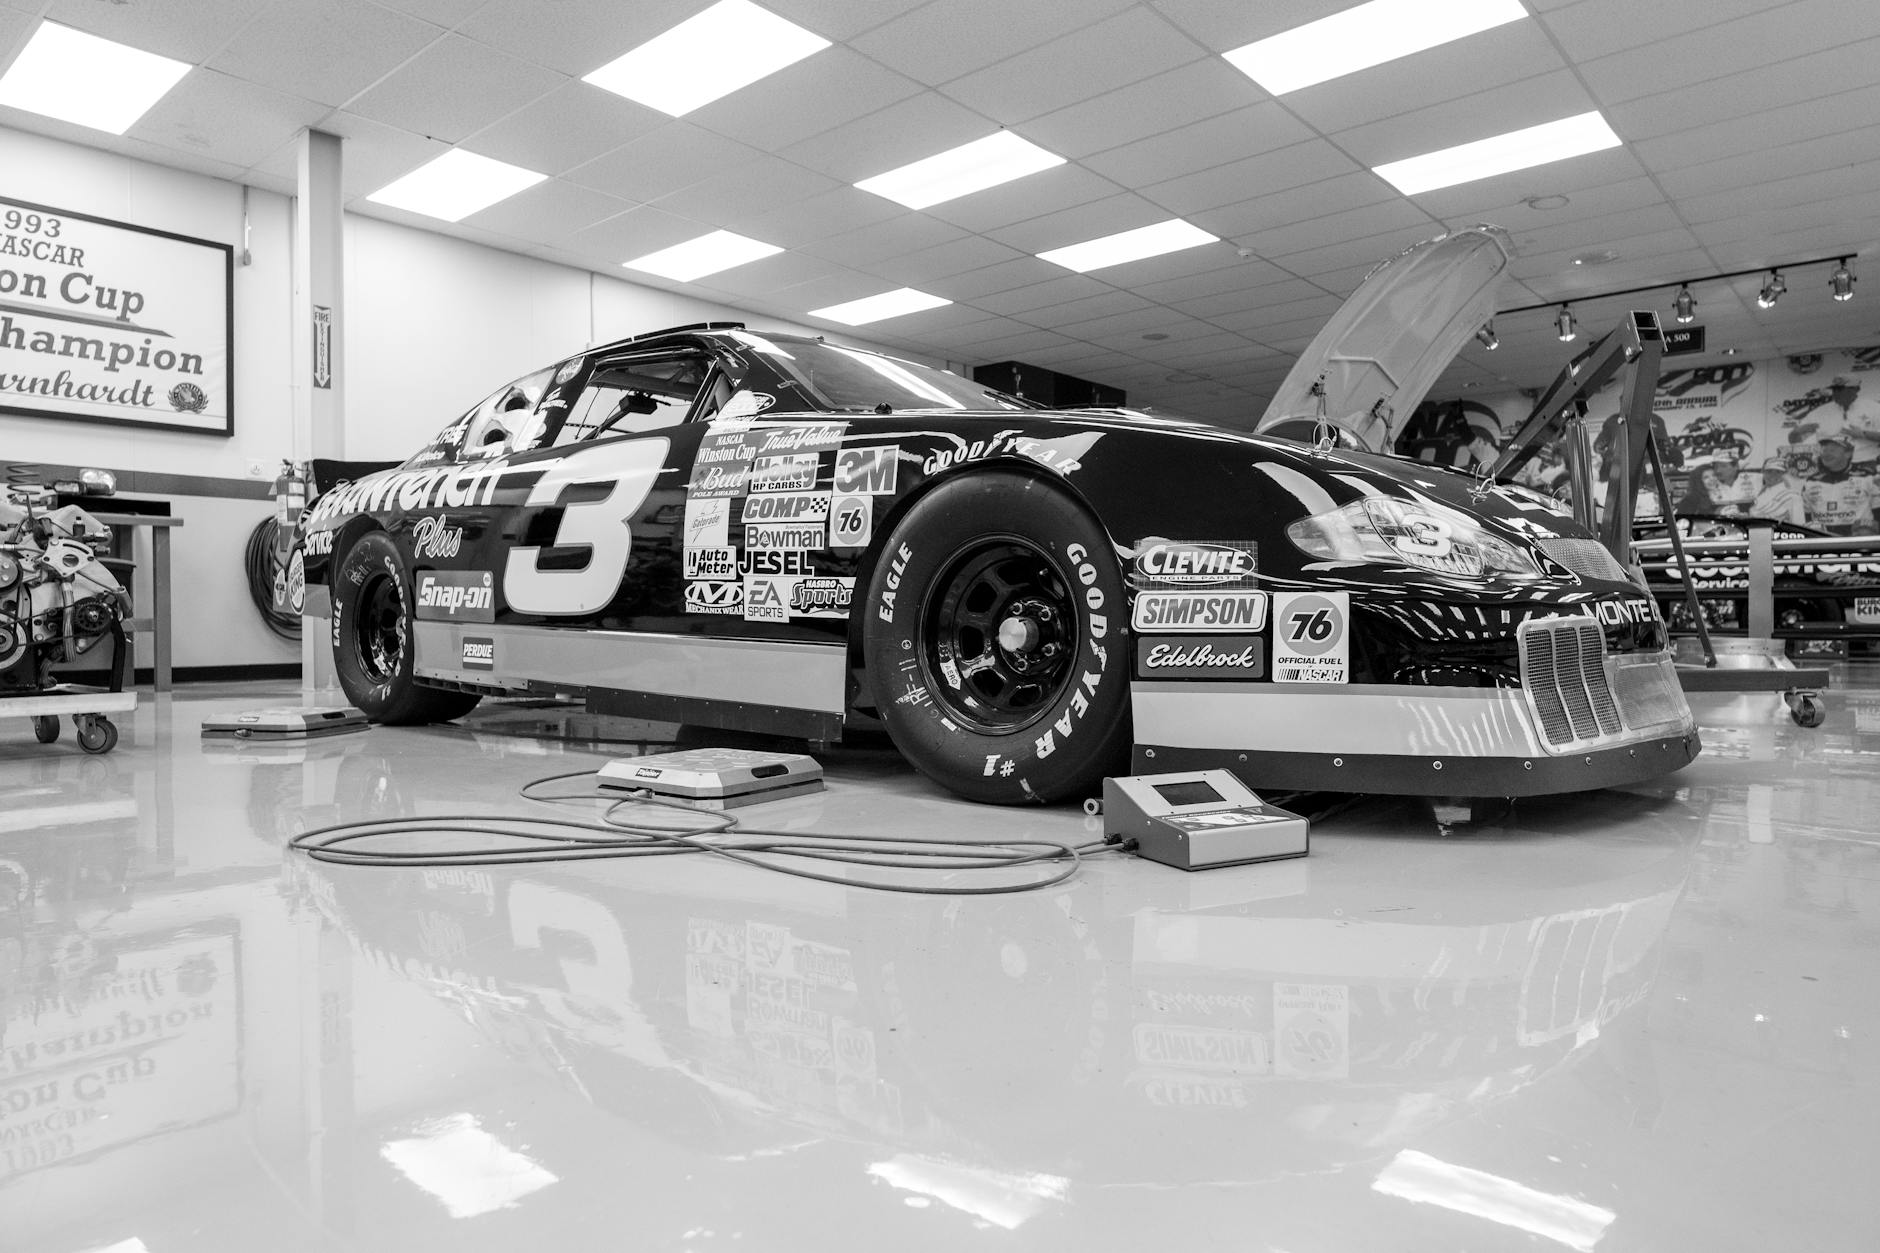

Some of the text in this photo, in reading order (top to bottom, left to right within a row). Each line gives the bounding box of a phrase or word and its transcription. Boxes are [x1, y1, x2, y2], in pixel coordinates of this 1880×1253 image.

[0, 233, 84, 268] ASCAR
[60, 271, 145, 322] Cup
[314, 312, 329, 323] FIRE
[0, 316, 203, 375] hampion
[1673, 333, 1690, 343] 500
[716, 434, 745, 446] NASCAR
[698, 444, 757, 463] Winston Cup
[923, 430, 1082, 476] GOODYEAR
[703, 466, 750, 490] Bud
[753, 456, 817, 489] Holley
[835, 450, 896, 493] 3M
[752, 481, 802, 491] HP CARBS
[744, 497, 811, 519] COMP
[838, 508, 863, 533] 76
[413, 513, 463, 559] Plus
[503, 437, 671, 616] 3
[1396, 514, 1451, 557] 3
[303, 526, 334, 557] Service
[697, 561, 734, 574] Meter
[699, 549, 729, 562] Auto
[739, 551, 813, 575] JESEL
[1143, 545, 1247, 574] CLEVITE
[748, 580, 782, 606] EA
[805, 579, 837, 589] HASBRO
[879, 541, 913, 623] EAGLE
[418, 577, 492, 615] Snap-on
[685, 602, 744, 615] MECHANIX WEAR
[790, 584, 853, 611] Sports
[333, 598, 343, 648] EAGLE
[748, 607, 784, 618] SPORTS
[1143, 598, 1256, 625] SIMPSON
[1289, 606, 1334, 642] 76
[1581, 600, 1652, 625] MONTE
[464, 643, 493, 658] PERDUE
[1034, 543, 1108, 760] GOODYEAR
[1146, 644, 1255, 669] Edelbrock
[1278, 657, 1317, 665] OFFICIAL
[944, 664, 959, 686] AERO
[1298, 669, 1343, 682] NASCAR
[984, 754, 1016, 778] #1
